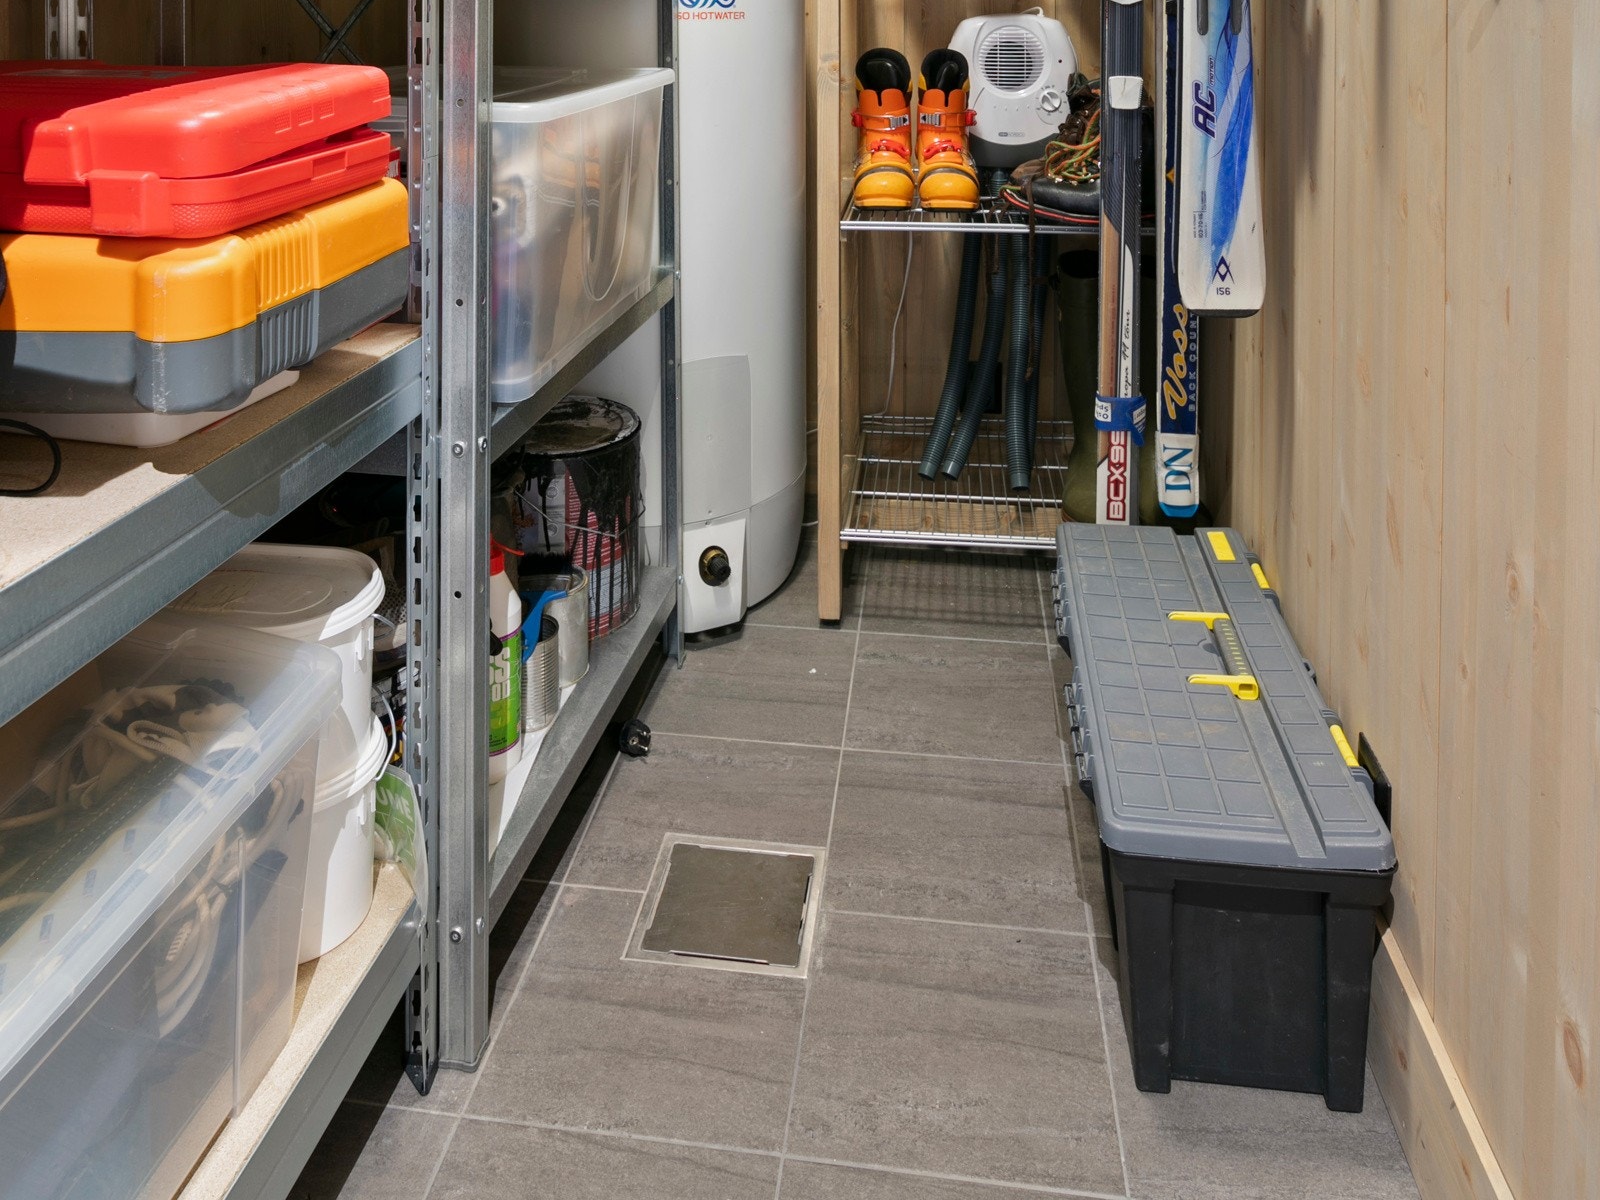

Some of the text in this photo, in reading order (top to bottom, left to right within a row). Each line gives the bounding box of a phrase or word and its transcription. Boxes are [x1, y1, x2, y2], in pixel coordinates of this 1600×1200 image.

[692, 11, 745, 20] HOTWATER
[1192, 80, 1217, 139] AC
[1216, 287, 1231, 296] 156
[1163, 303, 1188, 420] Voss
[1188, 370, 1196, 412] BACK
